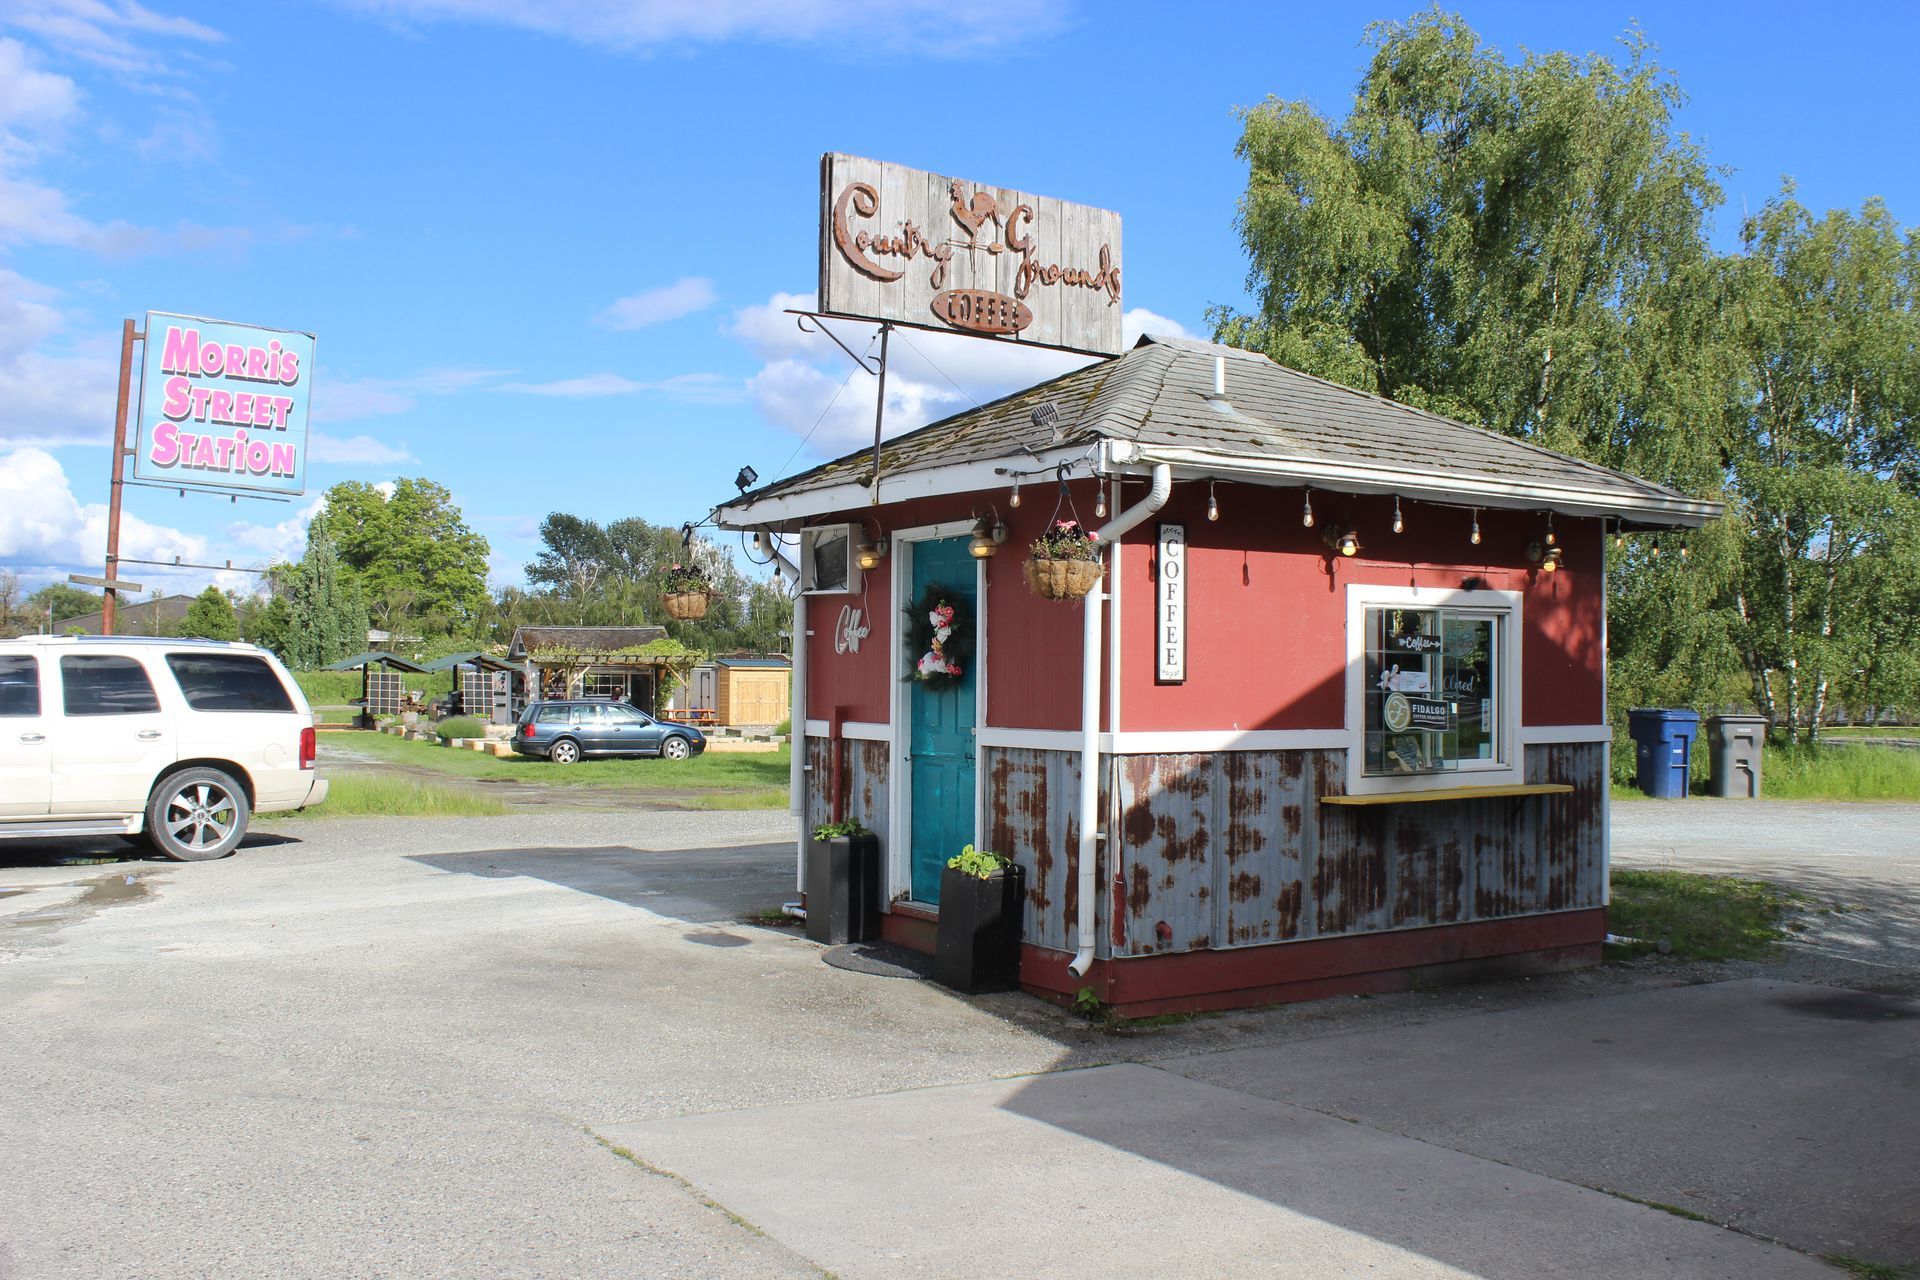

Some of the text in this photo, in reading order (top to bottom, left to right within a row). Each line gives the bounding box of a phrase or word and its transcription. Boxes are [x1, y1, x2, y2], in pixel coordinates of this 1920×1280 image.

[833, 183, 1120, 306] Country Grounds
[947, 293, 1020, 328] COFFEE
[162, 376, 294, 430] STREET
[1164, 538, 1181, 667] COFFEE
[835, 604, 870, 655] Coffee
[1406, 636, 1432, 651] Coffee
[1443, 674, 1474, 693] Closed
[1412, 704, 1445, 715] FIDALGO
